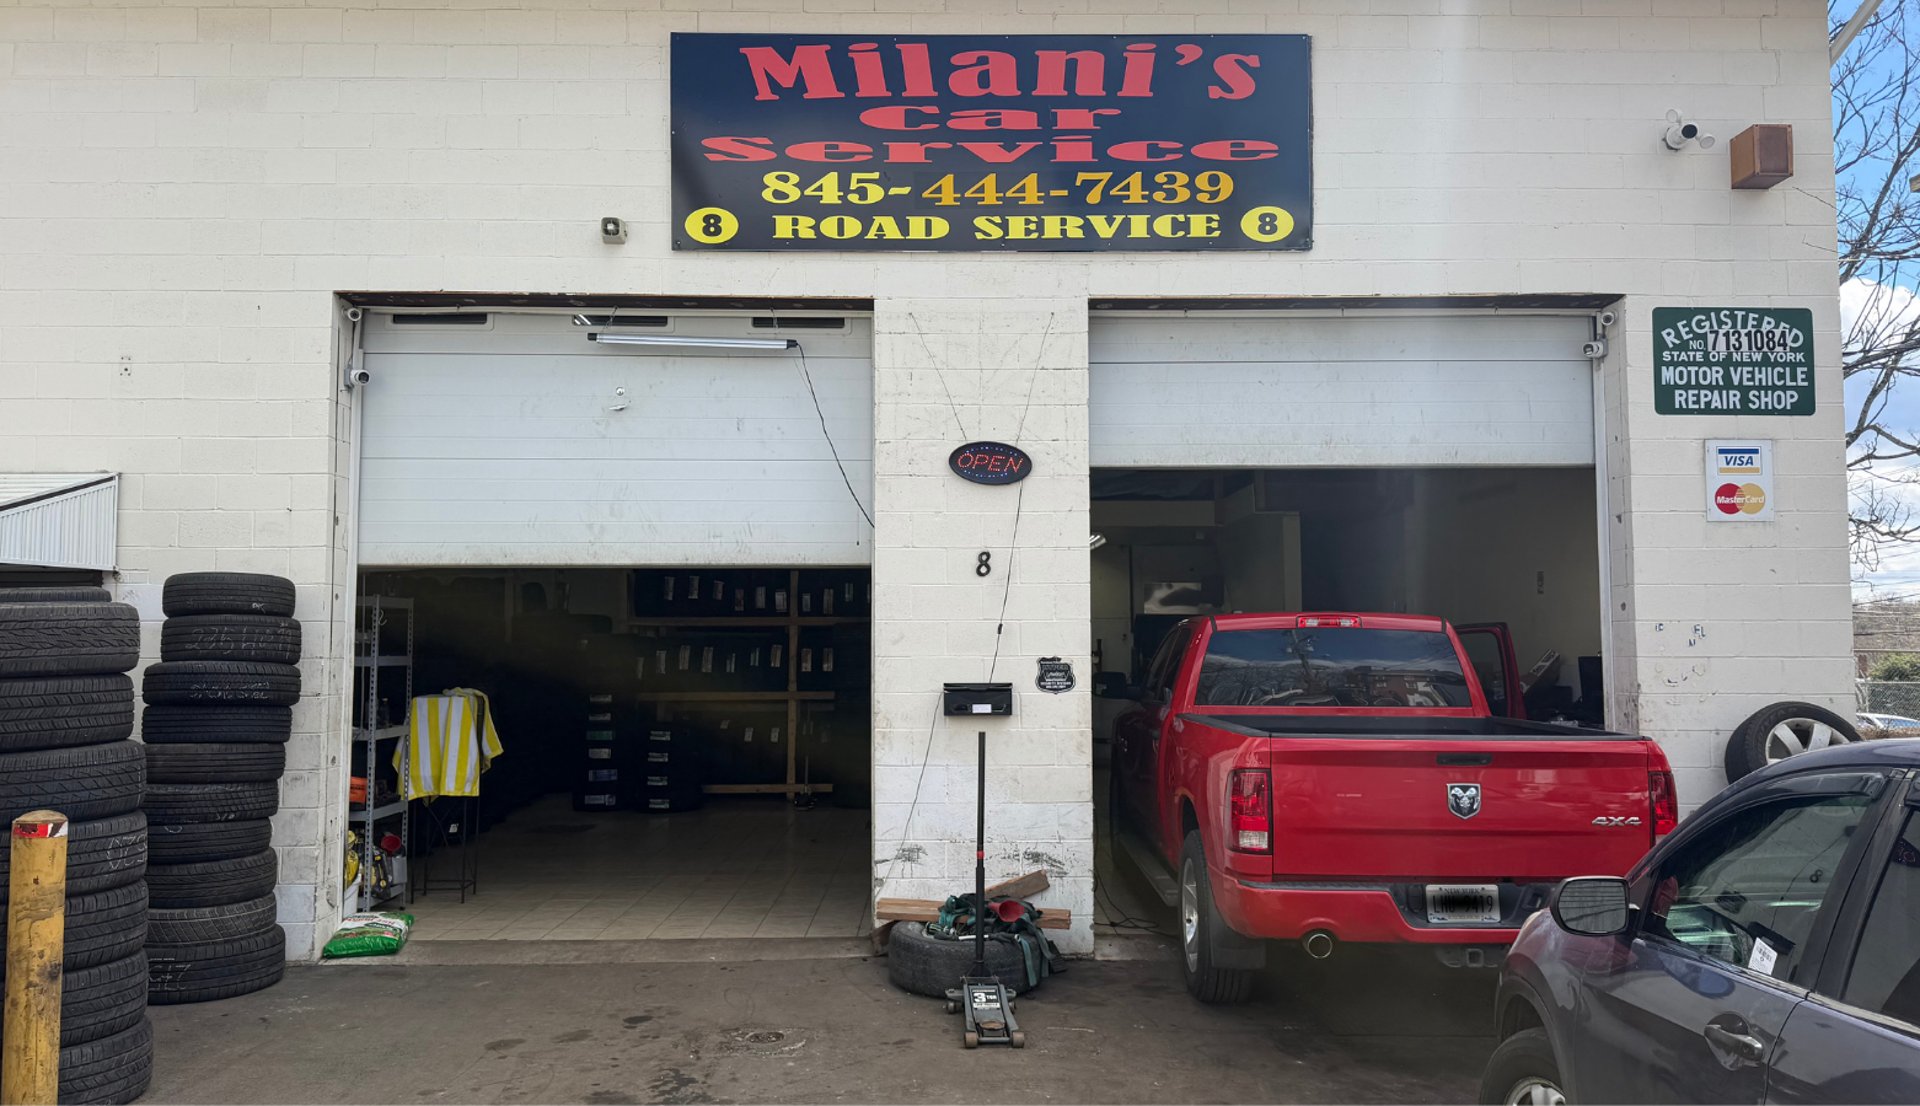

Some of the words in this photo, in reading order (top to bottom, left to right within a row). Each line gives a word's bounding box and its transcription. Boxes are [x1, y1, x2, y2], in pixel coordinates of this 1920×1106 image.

[739, 42, 1262, 101] Milani's
[701, 135, 1279, 163] Service
[702, 213, 722, 237] 8
[772, 214, 950, 240] ROAD
[973, 213, 1222, 240] SERVICE
[1257, 212, 1278, 236] 8
[1709, 330, 1788, 351] 7131084
[1662, 351, 1704, 362] STATE
[1709, 351, 1727, 362] OF
[1732, 351, 1763, 362] NEW
[1768, 352, 1805, 362] YORK
[1661, 366, 1723, 386] MOTOR
[1729, 367, 1809, 387] VEHICLE
[1674, 390, 1741, 409] REPAIR
[1748, 390, 1799, 410] SHOP
[957, 452, 1024, 473] OPEN
[1724, 455, 1754, 466] VISA
[1716, 495, 1765, 504] MasterCard
[976, 551, 991, 577] 8
[973, 992, 986, 1002] 3
